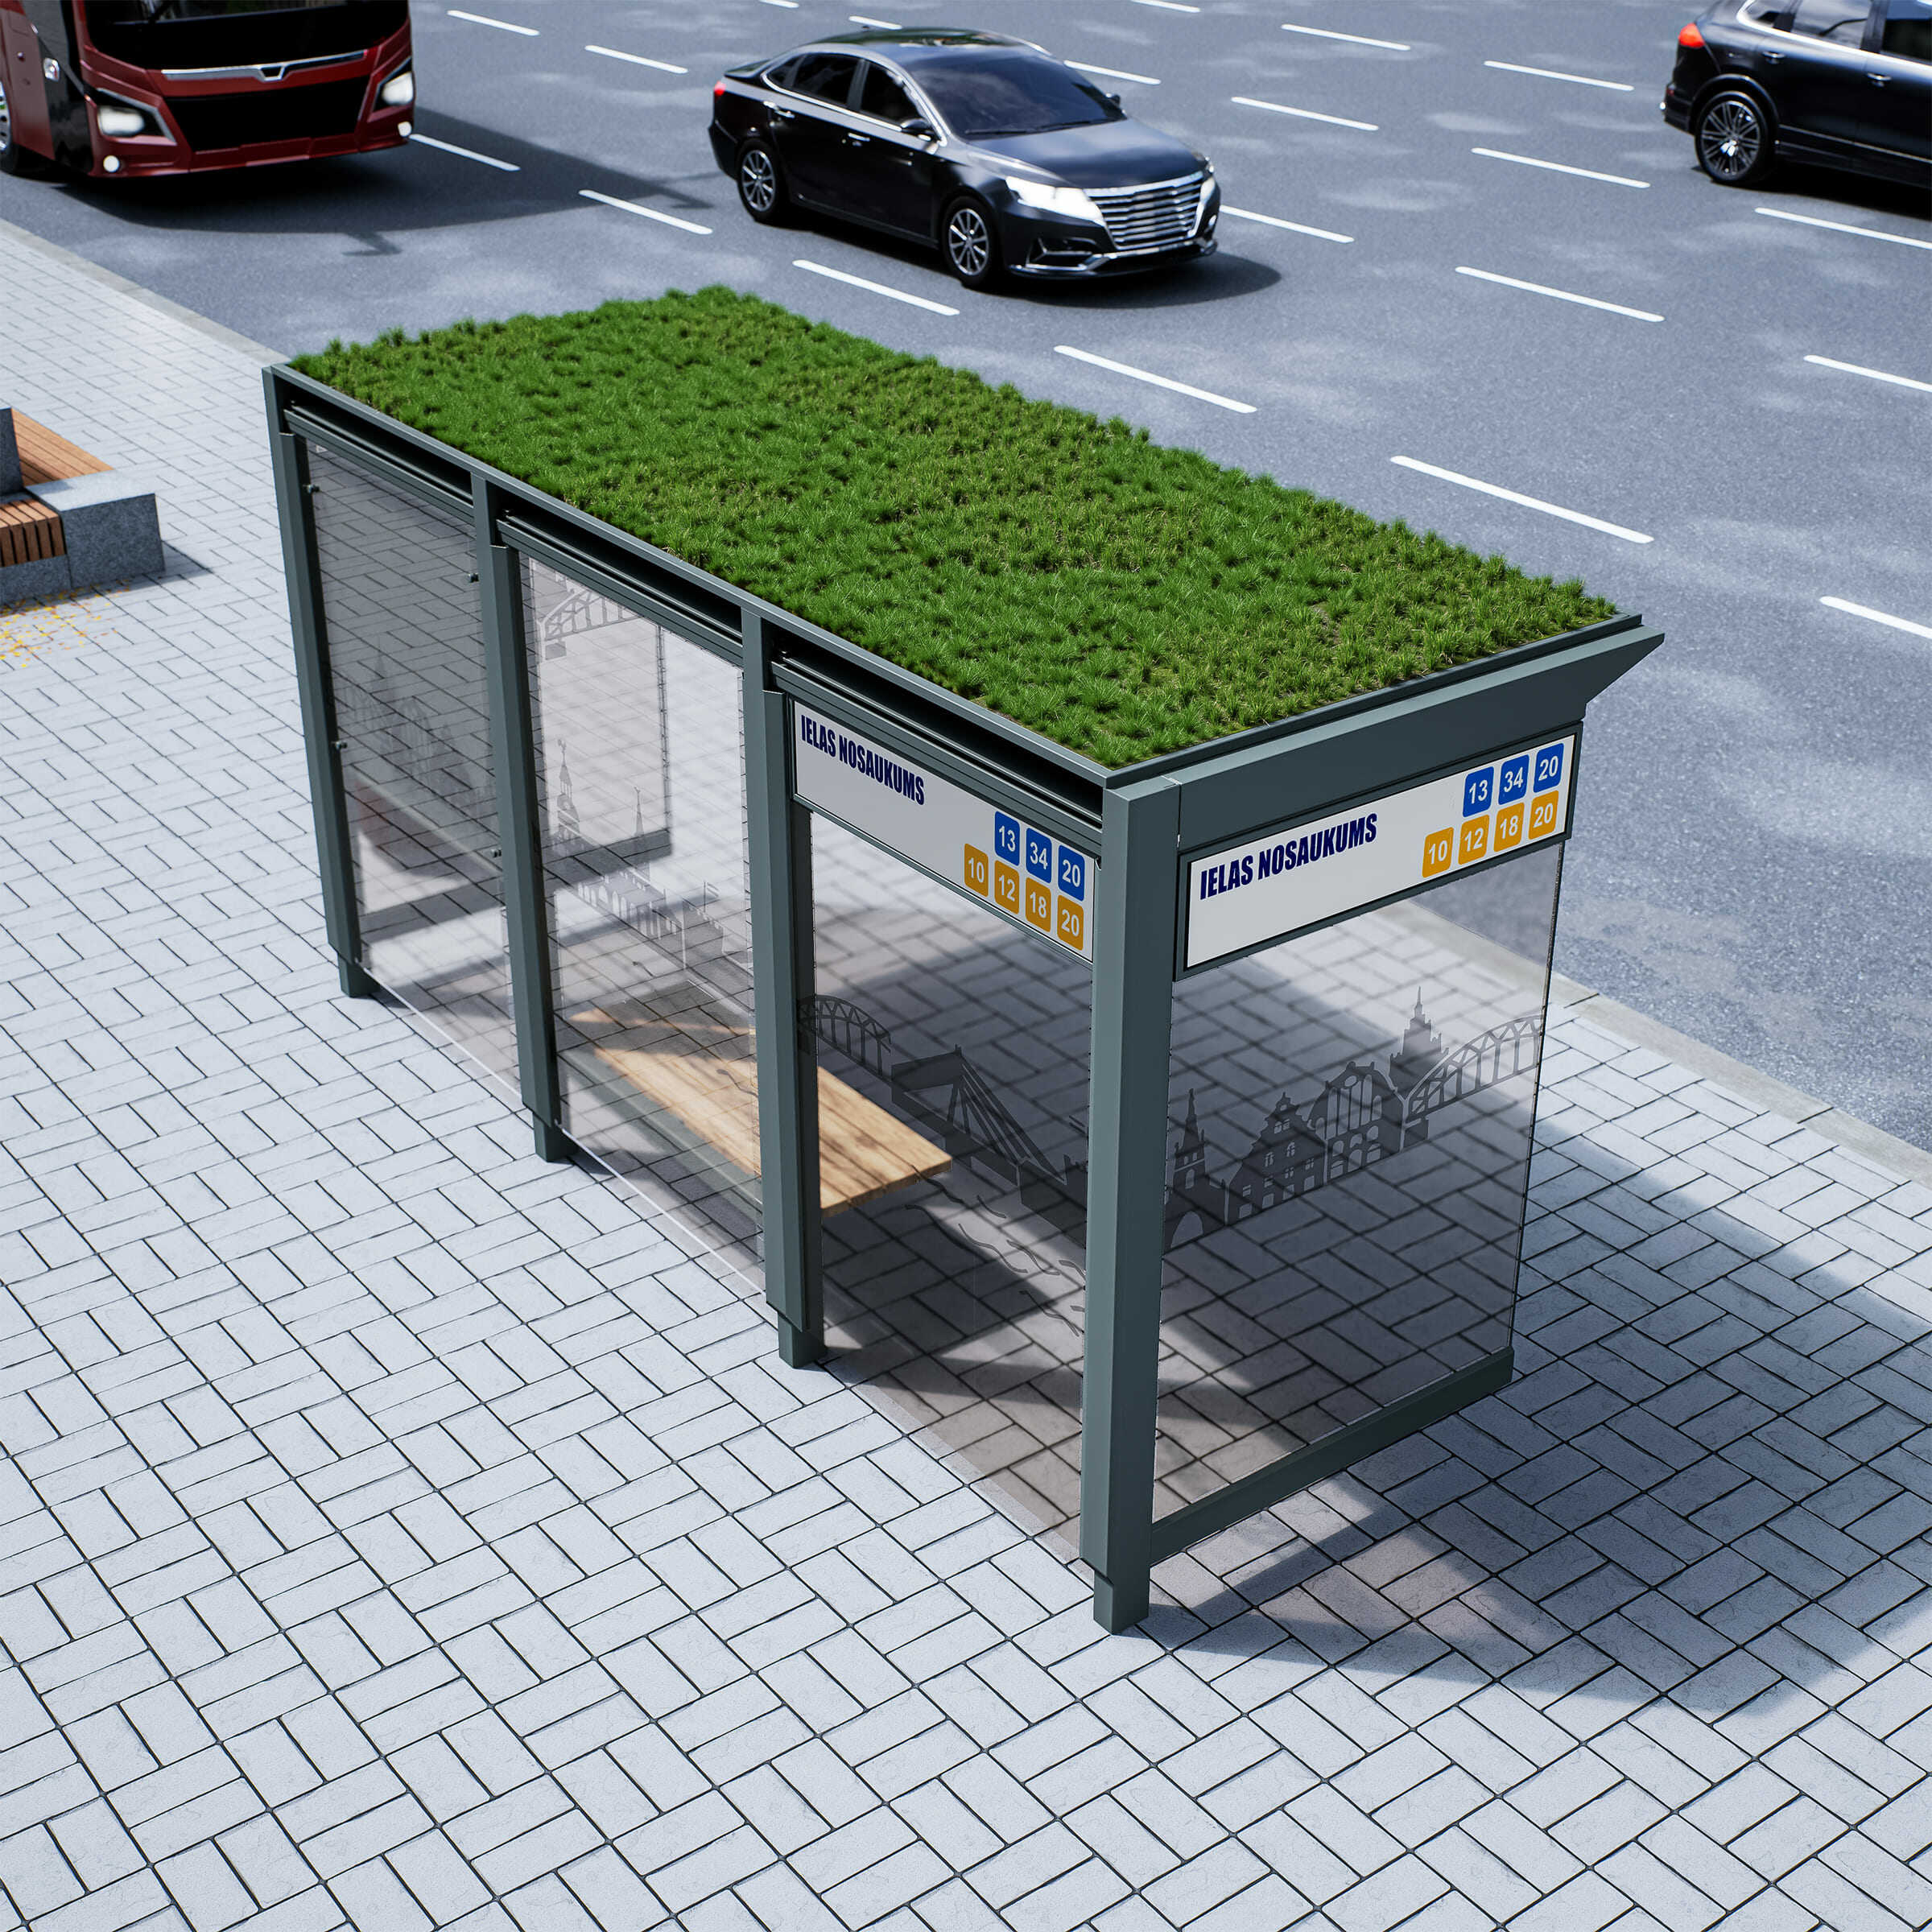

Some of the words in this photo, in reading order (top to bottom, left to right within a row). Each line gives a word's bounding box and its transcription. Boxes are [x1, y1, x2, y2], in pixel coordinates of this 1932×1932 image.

[801, 714, 836, 758] IELAS
[838, 734, 925, 806] NOSAUKUMS
[1468, 778, 1488, 804] 13
[1503, 766, 1525, 793] 34
[1538, 755, 1559, 782] 20
[998, 825, 1016, 852] 13
[1030, 841, 1048, 870] 34
[1062, 859, 1081, 888] 20
[1199, 855, 1253, 900] IELAS
[1257, 813, 1377, 880] NOSAUKUMS
[1428, 840, 1448, 865] 10
[1463, 827, 1484, 852] 12
[1500, 815, 1519, 840] 18
[1533, 803, 1554, 829] 20
[968, 857, 985, 883] 10
[998, 874, 1016, 902] 12
[1030, 891, 1047, 919] 18
[1061, 908, 1080, 937] 20
